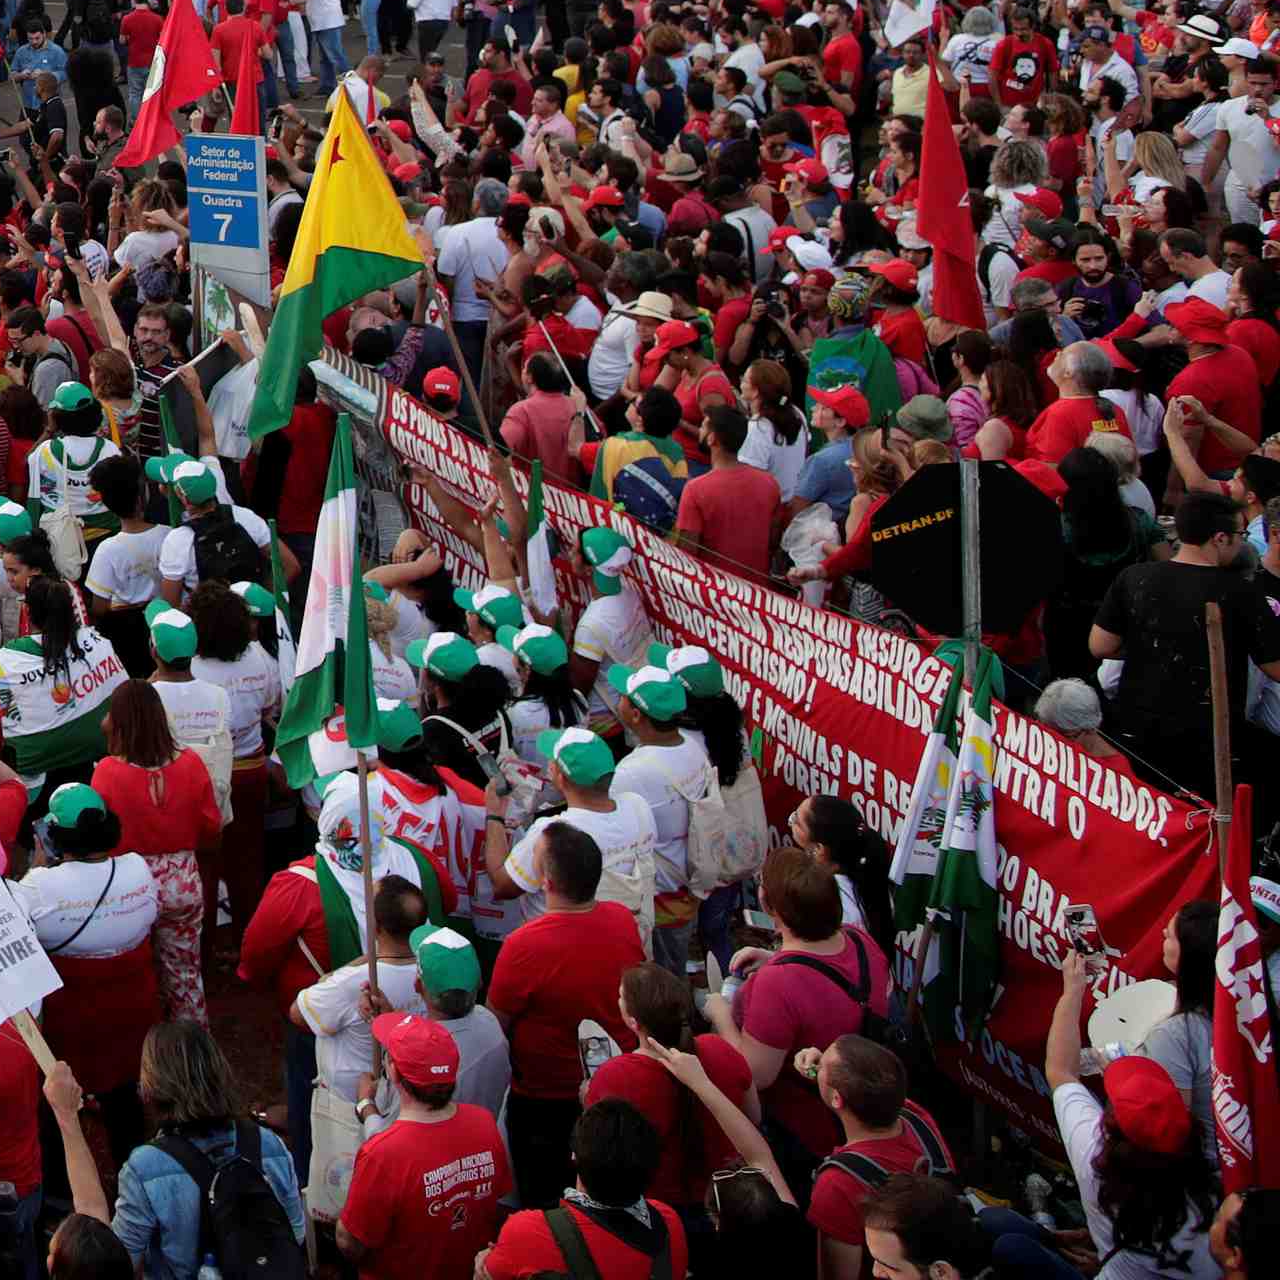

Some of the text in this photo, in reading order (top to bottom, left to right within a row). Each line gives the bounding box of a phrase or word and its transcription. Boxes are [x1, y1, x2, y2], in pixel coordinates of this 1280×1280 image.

[187, 156, 255, 172] Administração
[200, 145, 241, 158] Setor de
[203, 169, 239, 182] Federal
[201, 194, 243, 208] Quadra
[212, 212, 233, 242] 7
[871, 507, 956, 543] DETRAN-DF
[391, 390, 408, 424] OS
[409, 401, 449, 454] POVOS
[450, 423, 469, 465] DA
[1004, 711, 1173, 848] MOBILIZADOS,
[649, 560, 705, 614] TOTAL
[720, 595, 768, 647] COM
[1068, 795, 1086, 840] O
[762, 696, 844, 777] MENINAS
[846, 750, 878, 796] DE
